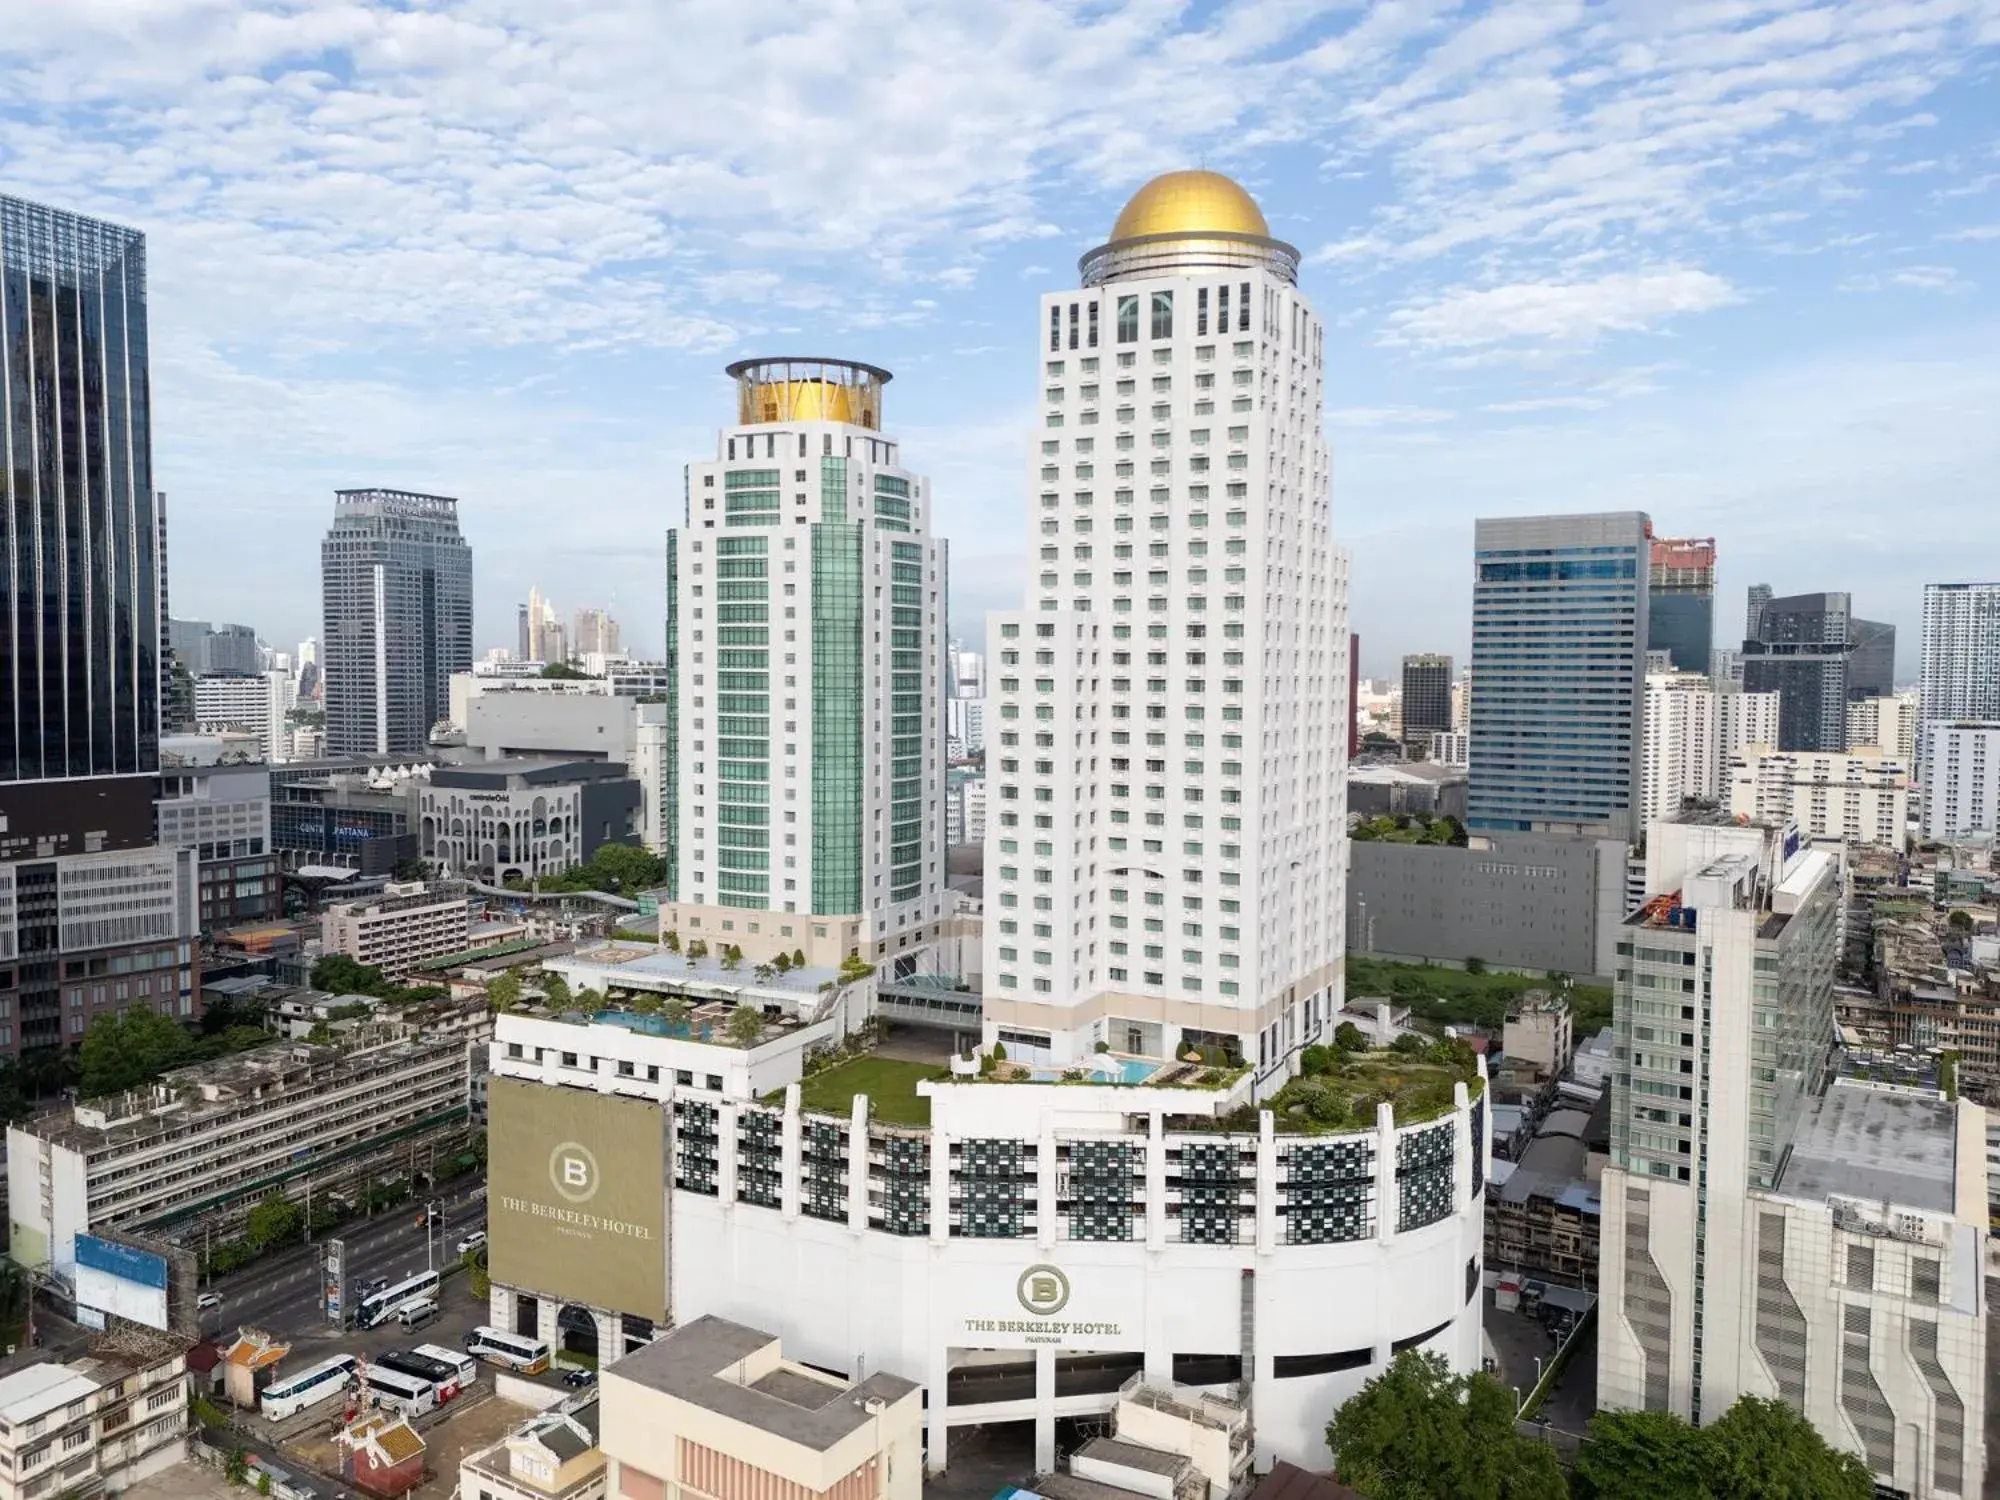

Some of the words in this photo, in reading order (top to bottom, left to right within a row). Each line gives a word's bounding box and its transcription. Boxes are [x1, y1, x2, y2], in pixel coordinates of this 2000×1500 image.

[564, 1156, 588, 1186] B
[500, 1196, 529, 1213] THE
[531, 1203, 600, 1228] BERKELEY
[600, 1218, 654, 1240] HOTEL
[1031, 1277, 1058, 1302] B
[965, 1320, 996, 1332] THE
[998, 1320, 1071, 1334] BERKELEY
[1073, 1322, 1122, 1336] HOTEL
